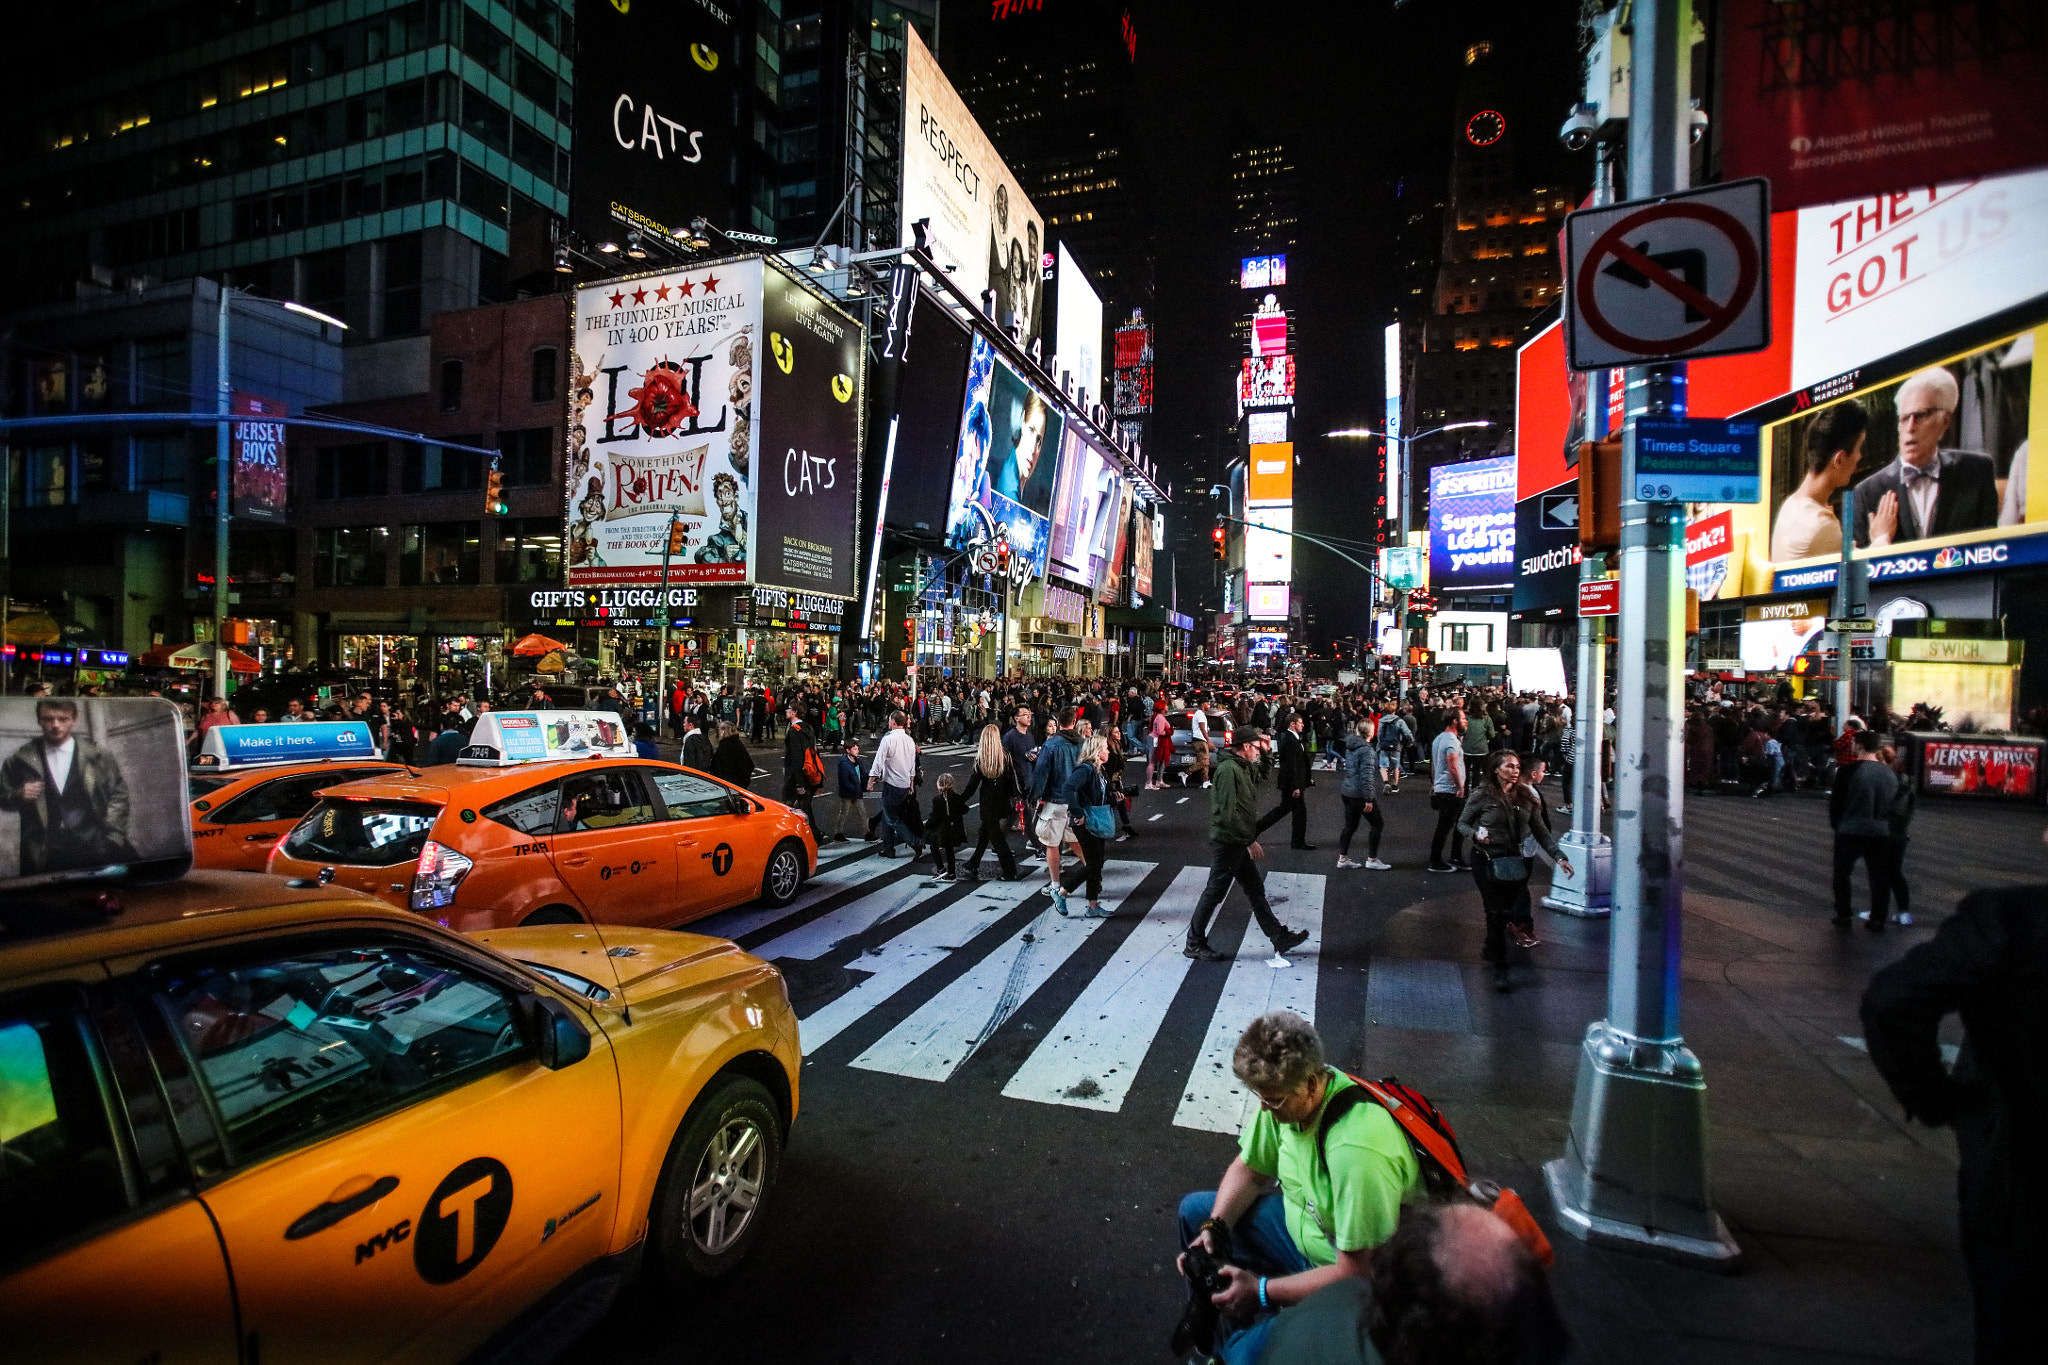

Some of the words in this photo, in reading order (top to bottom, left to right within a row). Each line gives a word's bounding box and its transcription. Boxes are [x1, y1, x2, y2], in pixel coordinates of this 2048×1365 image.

[614, 93, 704, 163] CATS
[921, 102, 981, 203] RESPECT
[1827, 234, 1919, 314] GOT
[586, 313, 611, 333] THE
[613, 304, 680, 328] FUNNIEST
[682, 292, 745, 319] MUSICAL
[607, 328, 624, 347] IN
[629, 324, 659, 346] 400
[795, 311, 812, 330] LIVE
[813, 324, 835, 344] AGAIN
[815, 311, 844, 339] MEMORY
[1814, 369, 1861, 394] MARRIOTT
[1242, 395, 1294, 407] TOSHIBA
[1814, 382, 1855, 403] MARQUIS
[235, 421, 284, 443] JERSEY
[241, 441, 279, 466] BOYS
[1641, 438, 1686, 452] Times
[1688, 438, 1741, 455] Square
[621, 452, 695, 469] SOMETHING
[1641, 455, 1717, 470] Pedestrian
[1719, 456, 1757, 471] Plaza
[784, 447, 837, 498] CATS
[606, 540, 624, 550] THE
[625, 540, 648, 549] BOOK
[649, 540, 662, 548] OF
[1964, 544, 2009, 567] NBC
[1521, 543, 1574, 576] swatch
[1581, 585, 1590, 593] NO
[1590, 583, 1614, 593] STANDING
[1781, 569, 1838, 588] TONIGHT
[530, 590, 586, 609] GIFTS
[600, 588, 698, 608] LUGGAGE
[752, 586, 788, 609] GIFTS
[795, 593, 845, 616] LUGGAGE
[1042, 583, 1085, 624] FOREVER
[1581, 593, 1602, 602] Anytime
[1761, 602, 1810, 619] INVICTA
[555, 618, 576, 627] Nikon
[580, 619, 607, 628] Canon
[613, 618, 641, 627] SONY
[809, 622, 828, 631] SONY
[1839, 621, 1854, 630] ONE
[1855, 621, 1872, 630] WAY
[173, 656, 197, 667] NUTS
[240, 736, 272, 748] Make
[275, 735, 284, 746] it
[287, 735, 316, 746] here.
[337, 731, 356, 742] citi
[471, 747, 489, 758] 7P49
[1927, 748, 1989, 766] JERSEY
[512, 842, 550, 857] 7P49
[717, 849, 729, 872] T
[355, 1218, 411, 1267] NYC
[439, 1174, 493, 1265] T
